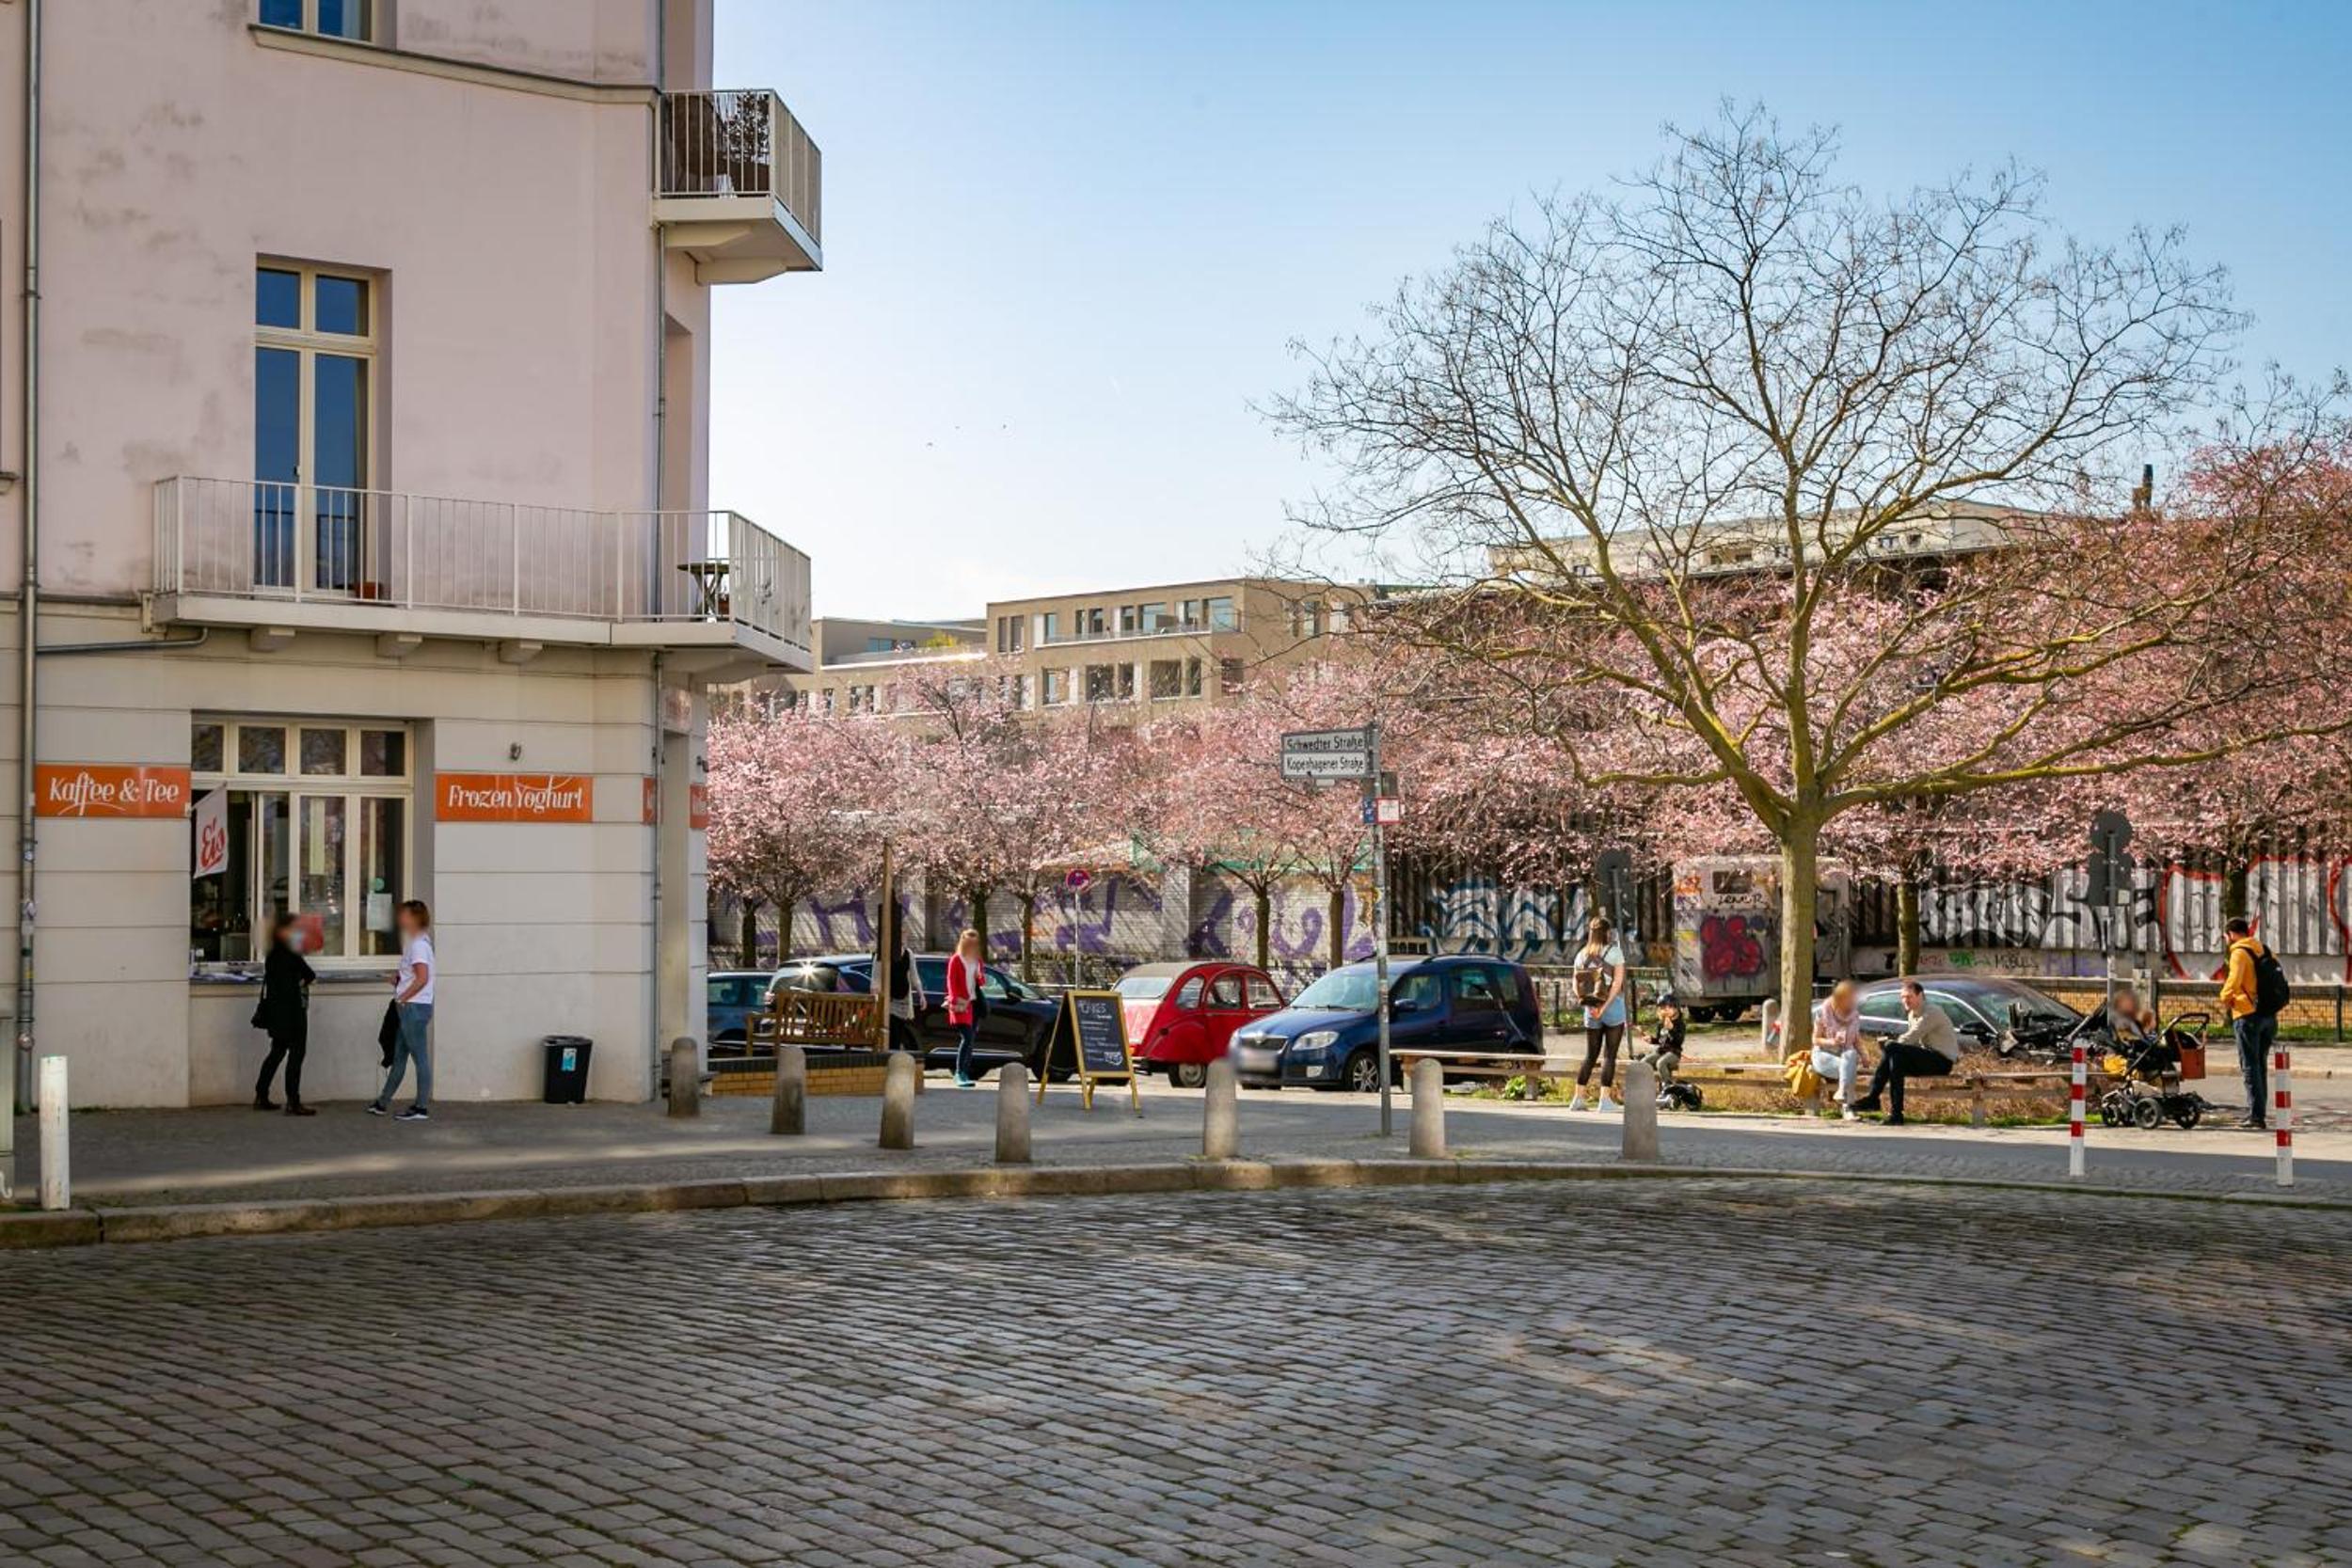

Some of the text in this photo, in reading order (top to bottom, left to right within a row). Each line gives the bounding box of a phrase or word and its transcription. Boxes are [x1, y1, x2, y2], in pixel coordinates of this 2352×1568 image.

[1287, 736, 1331, 751] Schwedter
[1287, 755, 1338, 772] Kopenhagener
[50, 771, 179, 816] Kaffee & Tee
[449, 775, 582, 814] Frozen Yoghurt
[200, 816, 226, 867] Eis
